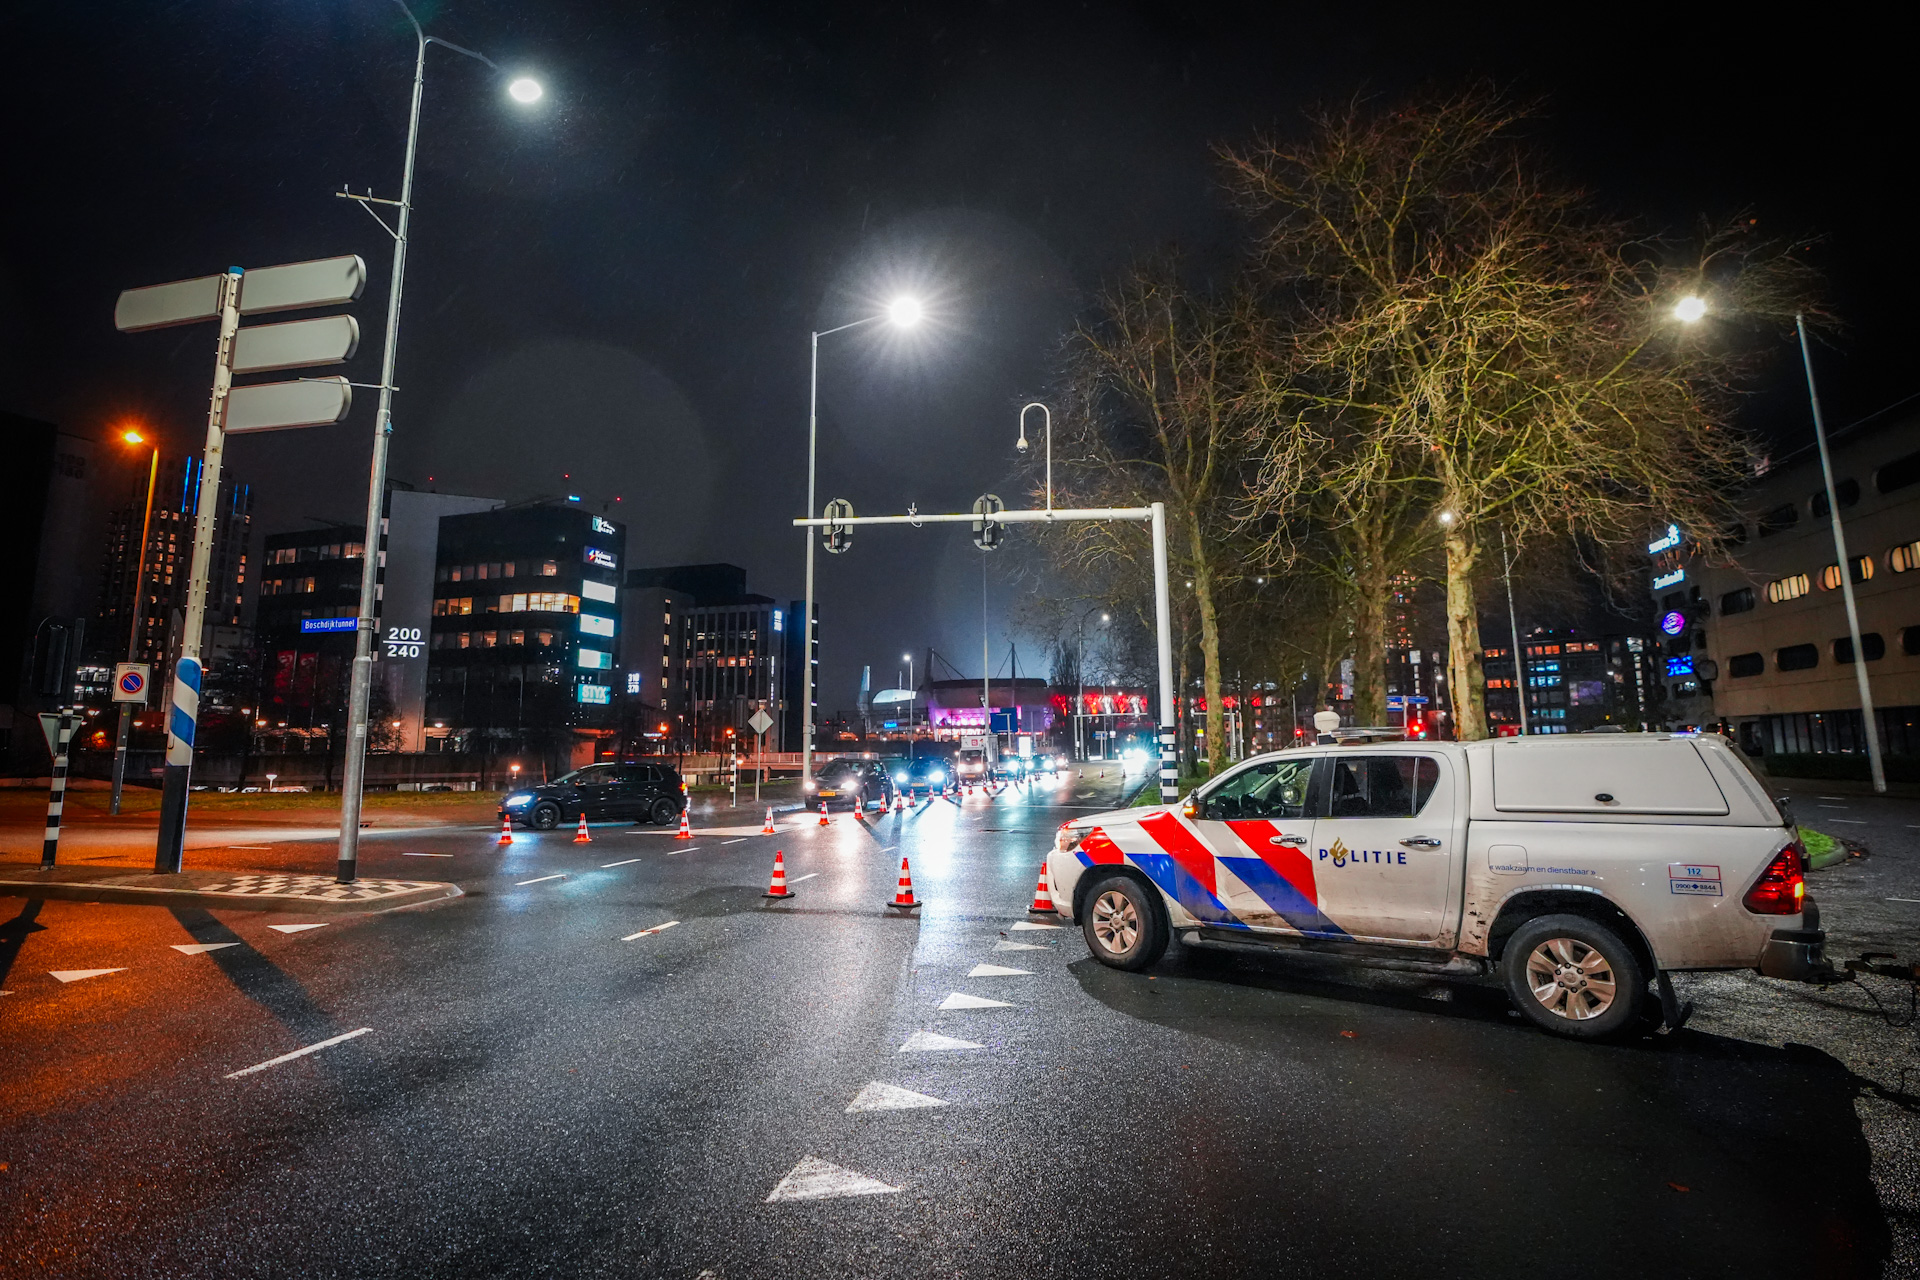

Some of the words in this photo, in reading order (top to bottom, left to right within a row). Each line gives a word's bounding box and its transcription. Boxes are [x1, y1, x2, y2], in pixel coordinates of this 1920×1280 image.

[305, 619, 355, 630] Boschdijktunnel
[388, 627, 421, 641] 200
[387, 645, 419, 658] 240
[581, 684, 607, 699] STYX
[627, 684, 639, 693] 370
[1319, 849, 1407, 867] POLITIE
[1495, 864, 1535, 872] waakzaam
[1547, 866, 1589, 875] dienstbaar
